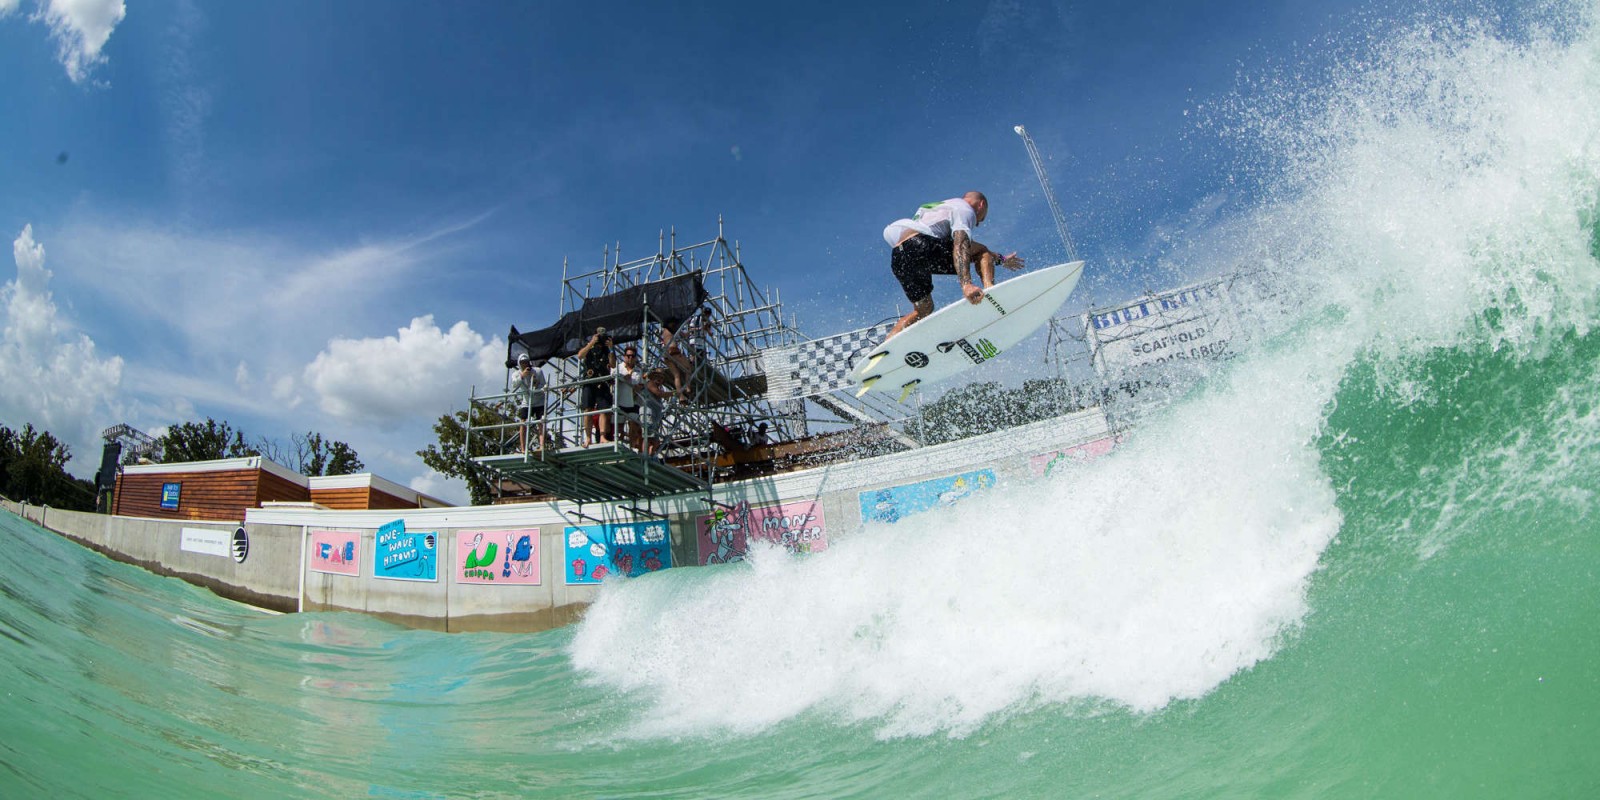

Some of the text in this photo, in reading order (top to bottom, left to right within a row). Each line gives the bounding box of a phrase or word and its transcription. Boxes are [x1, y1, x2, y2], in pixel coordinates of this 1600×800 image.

[984, 293, 1007, 316] BRIXTON
[1132, 327, 1206, 356] SCAFFOLD
[763, 513, 817, 533] MON-
[379, 529, 401, 543] ONE-
[781, 526, 822, 543] STER
[389, 537, 414, 552] WAVE
[383, 548, 417, 567] HITOUT
[464, 568, 495, 581] CHIPPA
